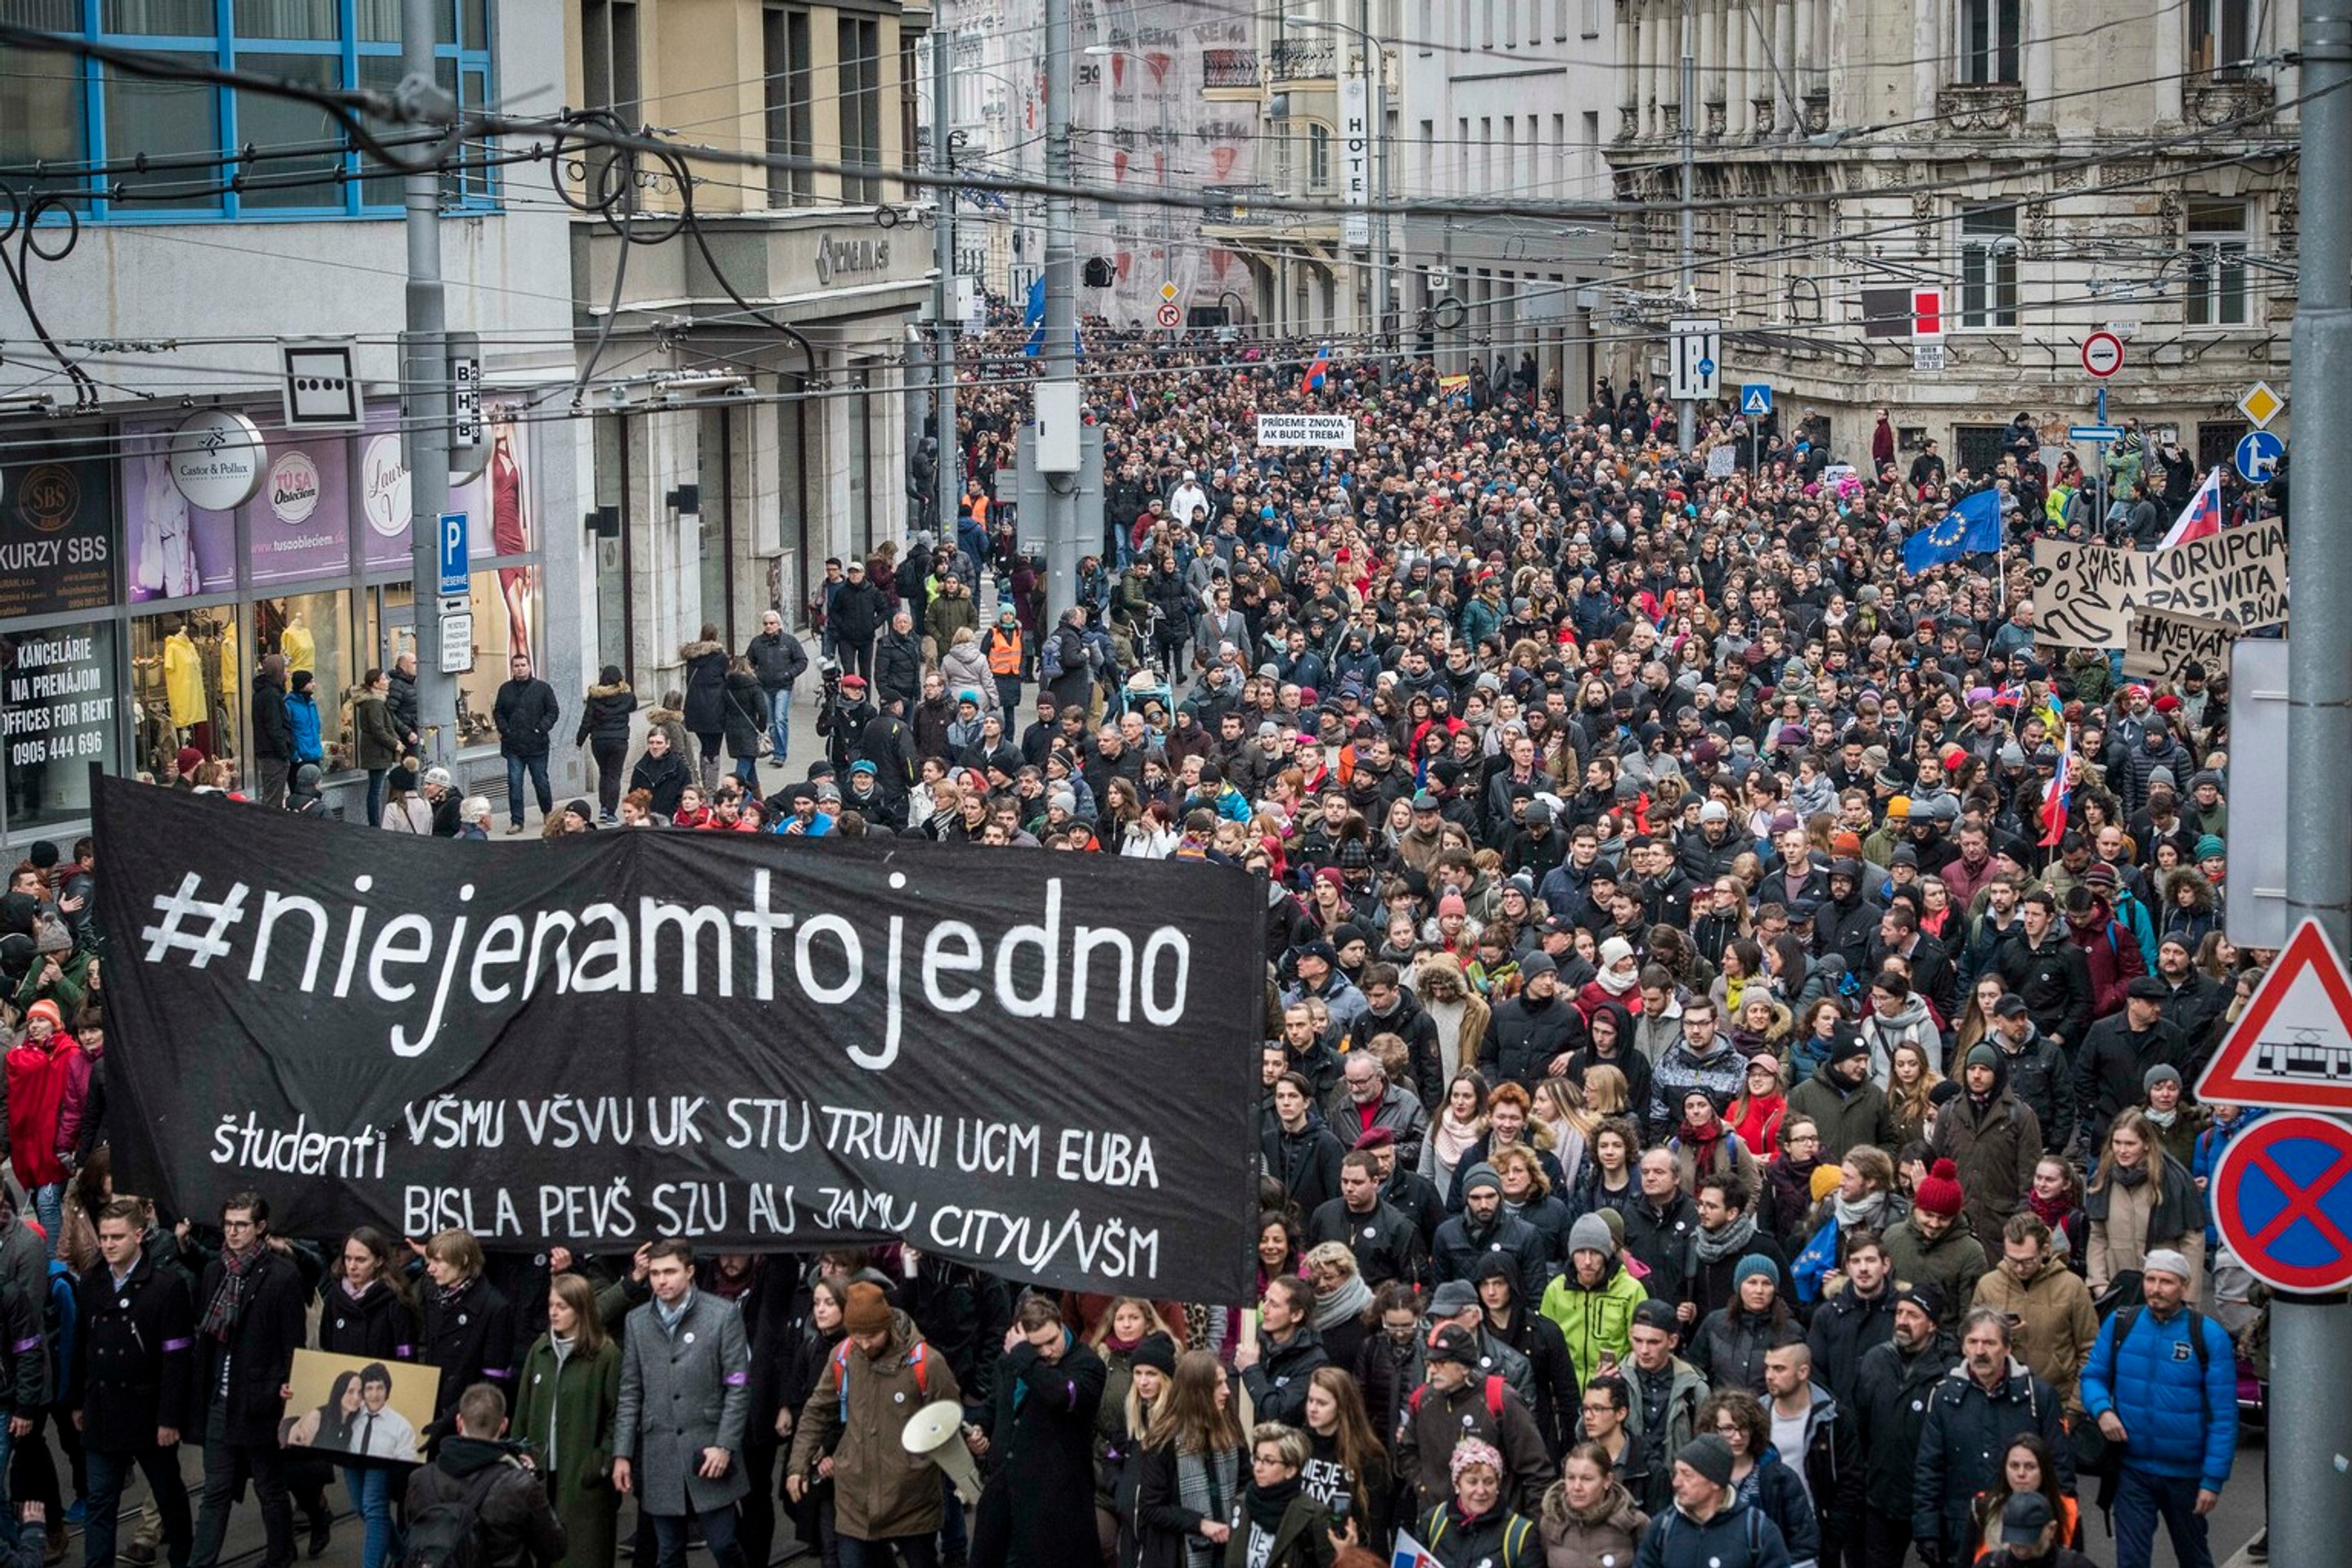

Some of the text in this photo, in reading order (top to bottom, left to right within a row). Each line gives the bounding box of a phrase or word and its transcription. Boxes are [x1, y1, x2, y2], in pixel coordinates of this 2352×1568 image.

[1262, 416, 1346, 429] PRÍDEME ZNOVA,
[1263, 430, 1344, 439] AK BUDE TREBA!
[180, 462, 247, 476] Castor & Pollux
[33, 485, 66, 510] SBS
[67, 536, 107, 564] SBS
[447, 521, 461, 565] P
[2147, 525, 2285, 587] KORUPCIA
[2119, 564, 2277, 612] A PASIVITA
[18, 635, 91, 669] KANCELÁRIE
[11, 666, 100, 702] NA PRENÁJOM
[54, 703, 78, 728] FOR
[82, 697, 113, 723] RENT
[13, 731, 102, 766] 0905 444 696
[141, 869, 1189, 1070] #niejenamtojedno
[210, 1111, 386, 1178] študenti
[404, 1093, 1159, 1189] VŠMU VŠVU UK STU TRUNI UCM EUBA
[539, 1176, 636, 1237] PEVŠ
[653, 1182, 728, 1236] SZU
[749, 1184, 795, 1234] AU
[813, 1188, 916, 1232] JAMU
